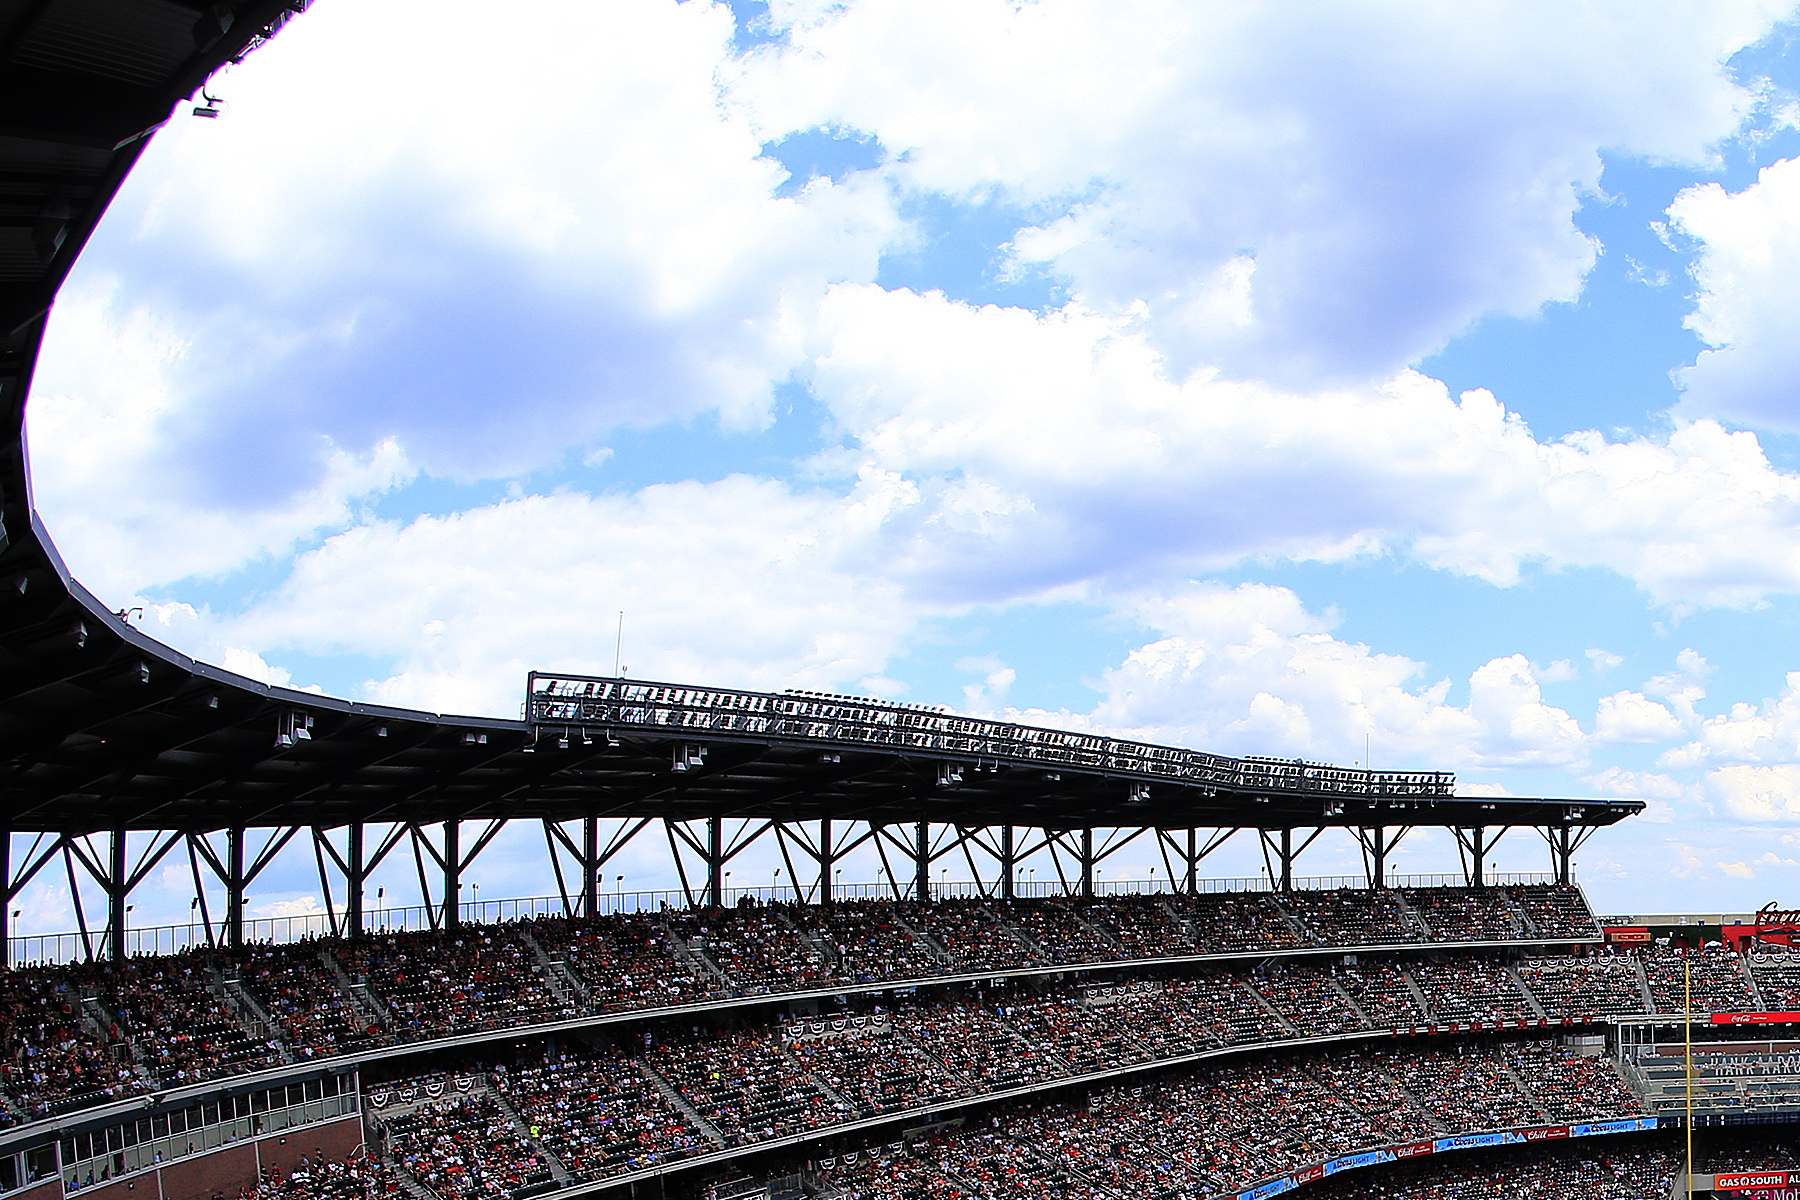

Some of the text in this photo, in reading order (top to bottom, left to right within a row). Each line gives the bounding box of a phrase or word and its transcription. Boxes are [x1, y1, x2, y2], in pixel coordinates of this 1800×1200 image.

[1605, 1014, 1618, 1025] 42
[1711, 1056, 1754, 1076] HANK
[1719, 1176, 1783, 1187] GAS SOUTH
[1789, 1174, 1800, 1184] AL
